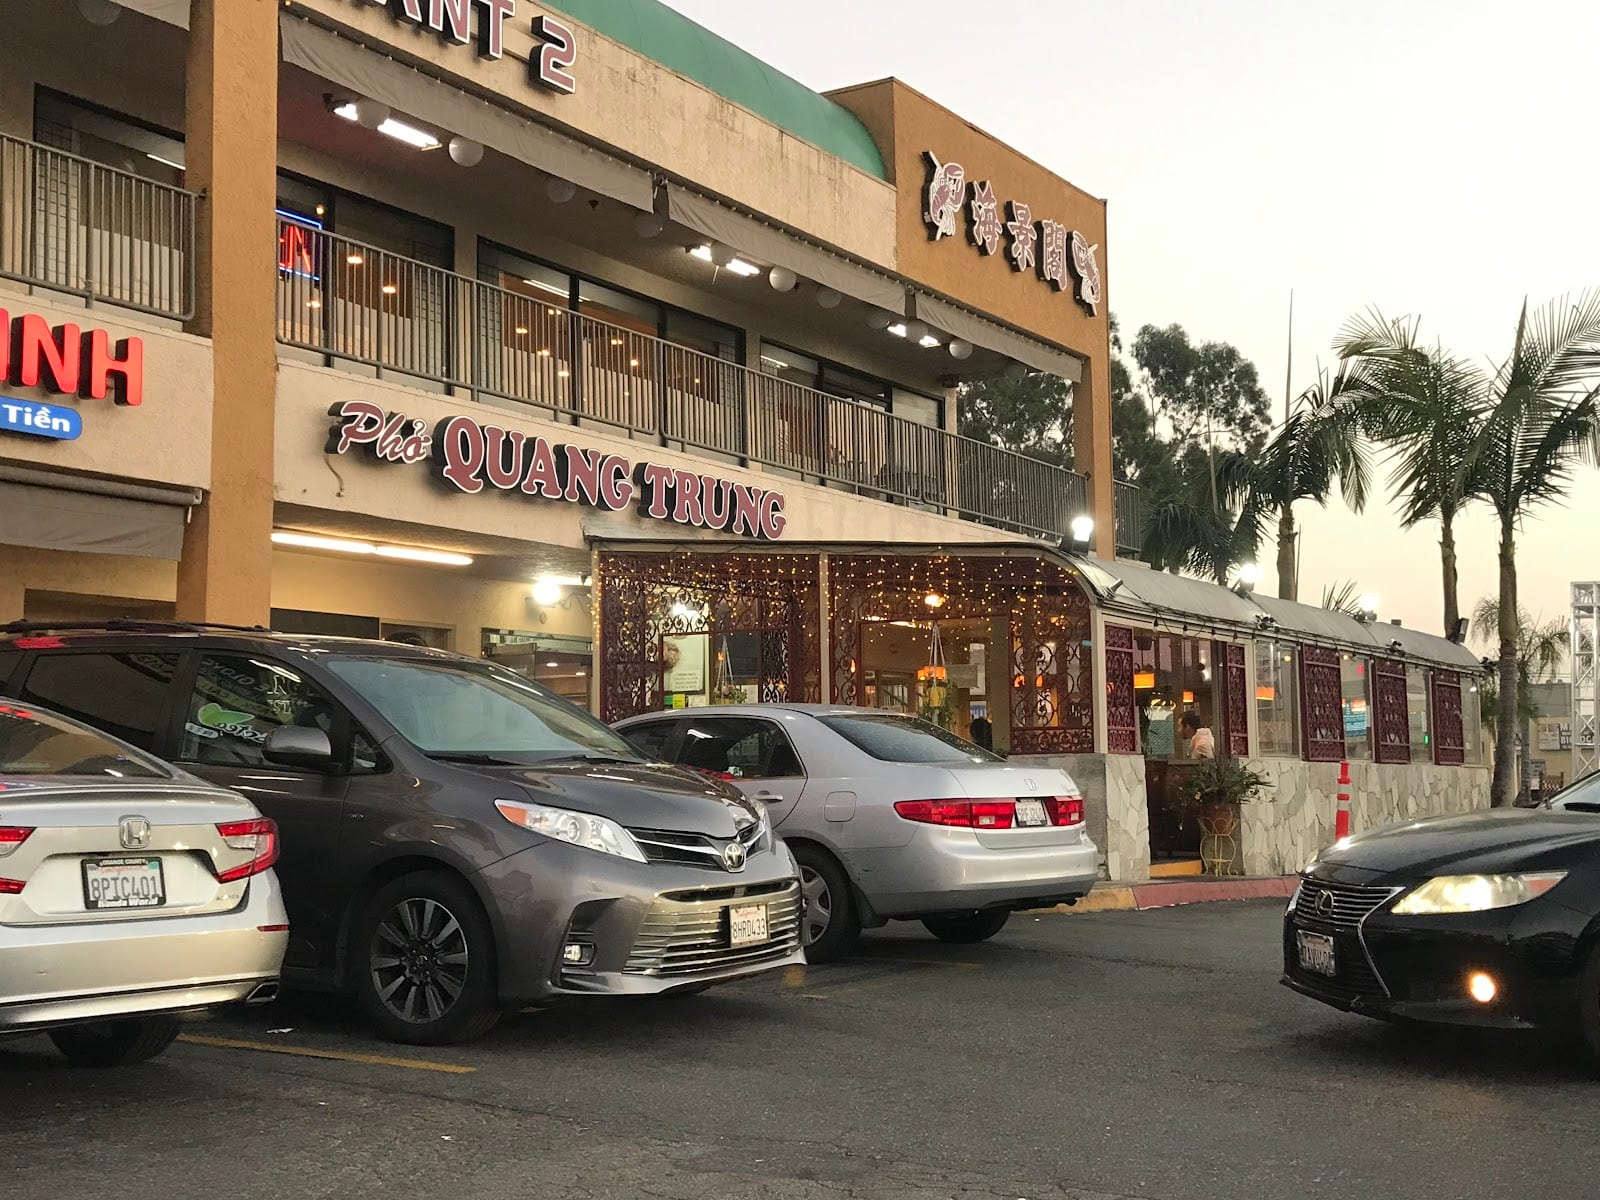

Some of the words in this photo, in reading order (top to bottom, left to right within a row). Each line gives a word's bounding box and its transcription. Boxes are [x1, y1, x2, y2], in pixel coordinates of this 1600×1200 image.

[541, 14, 577, 94] 2
[2, 404, 71, 432] Tiền
[338, 401, 432, 464] Phở
[443, 415, 634, 512] QUANG
[644, 461, 787, 540] TRUNG
[91, 876, 160, 901] 8PIC401
[732, 918, 766, 940] 8HRD433
